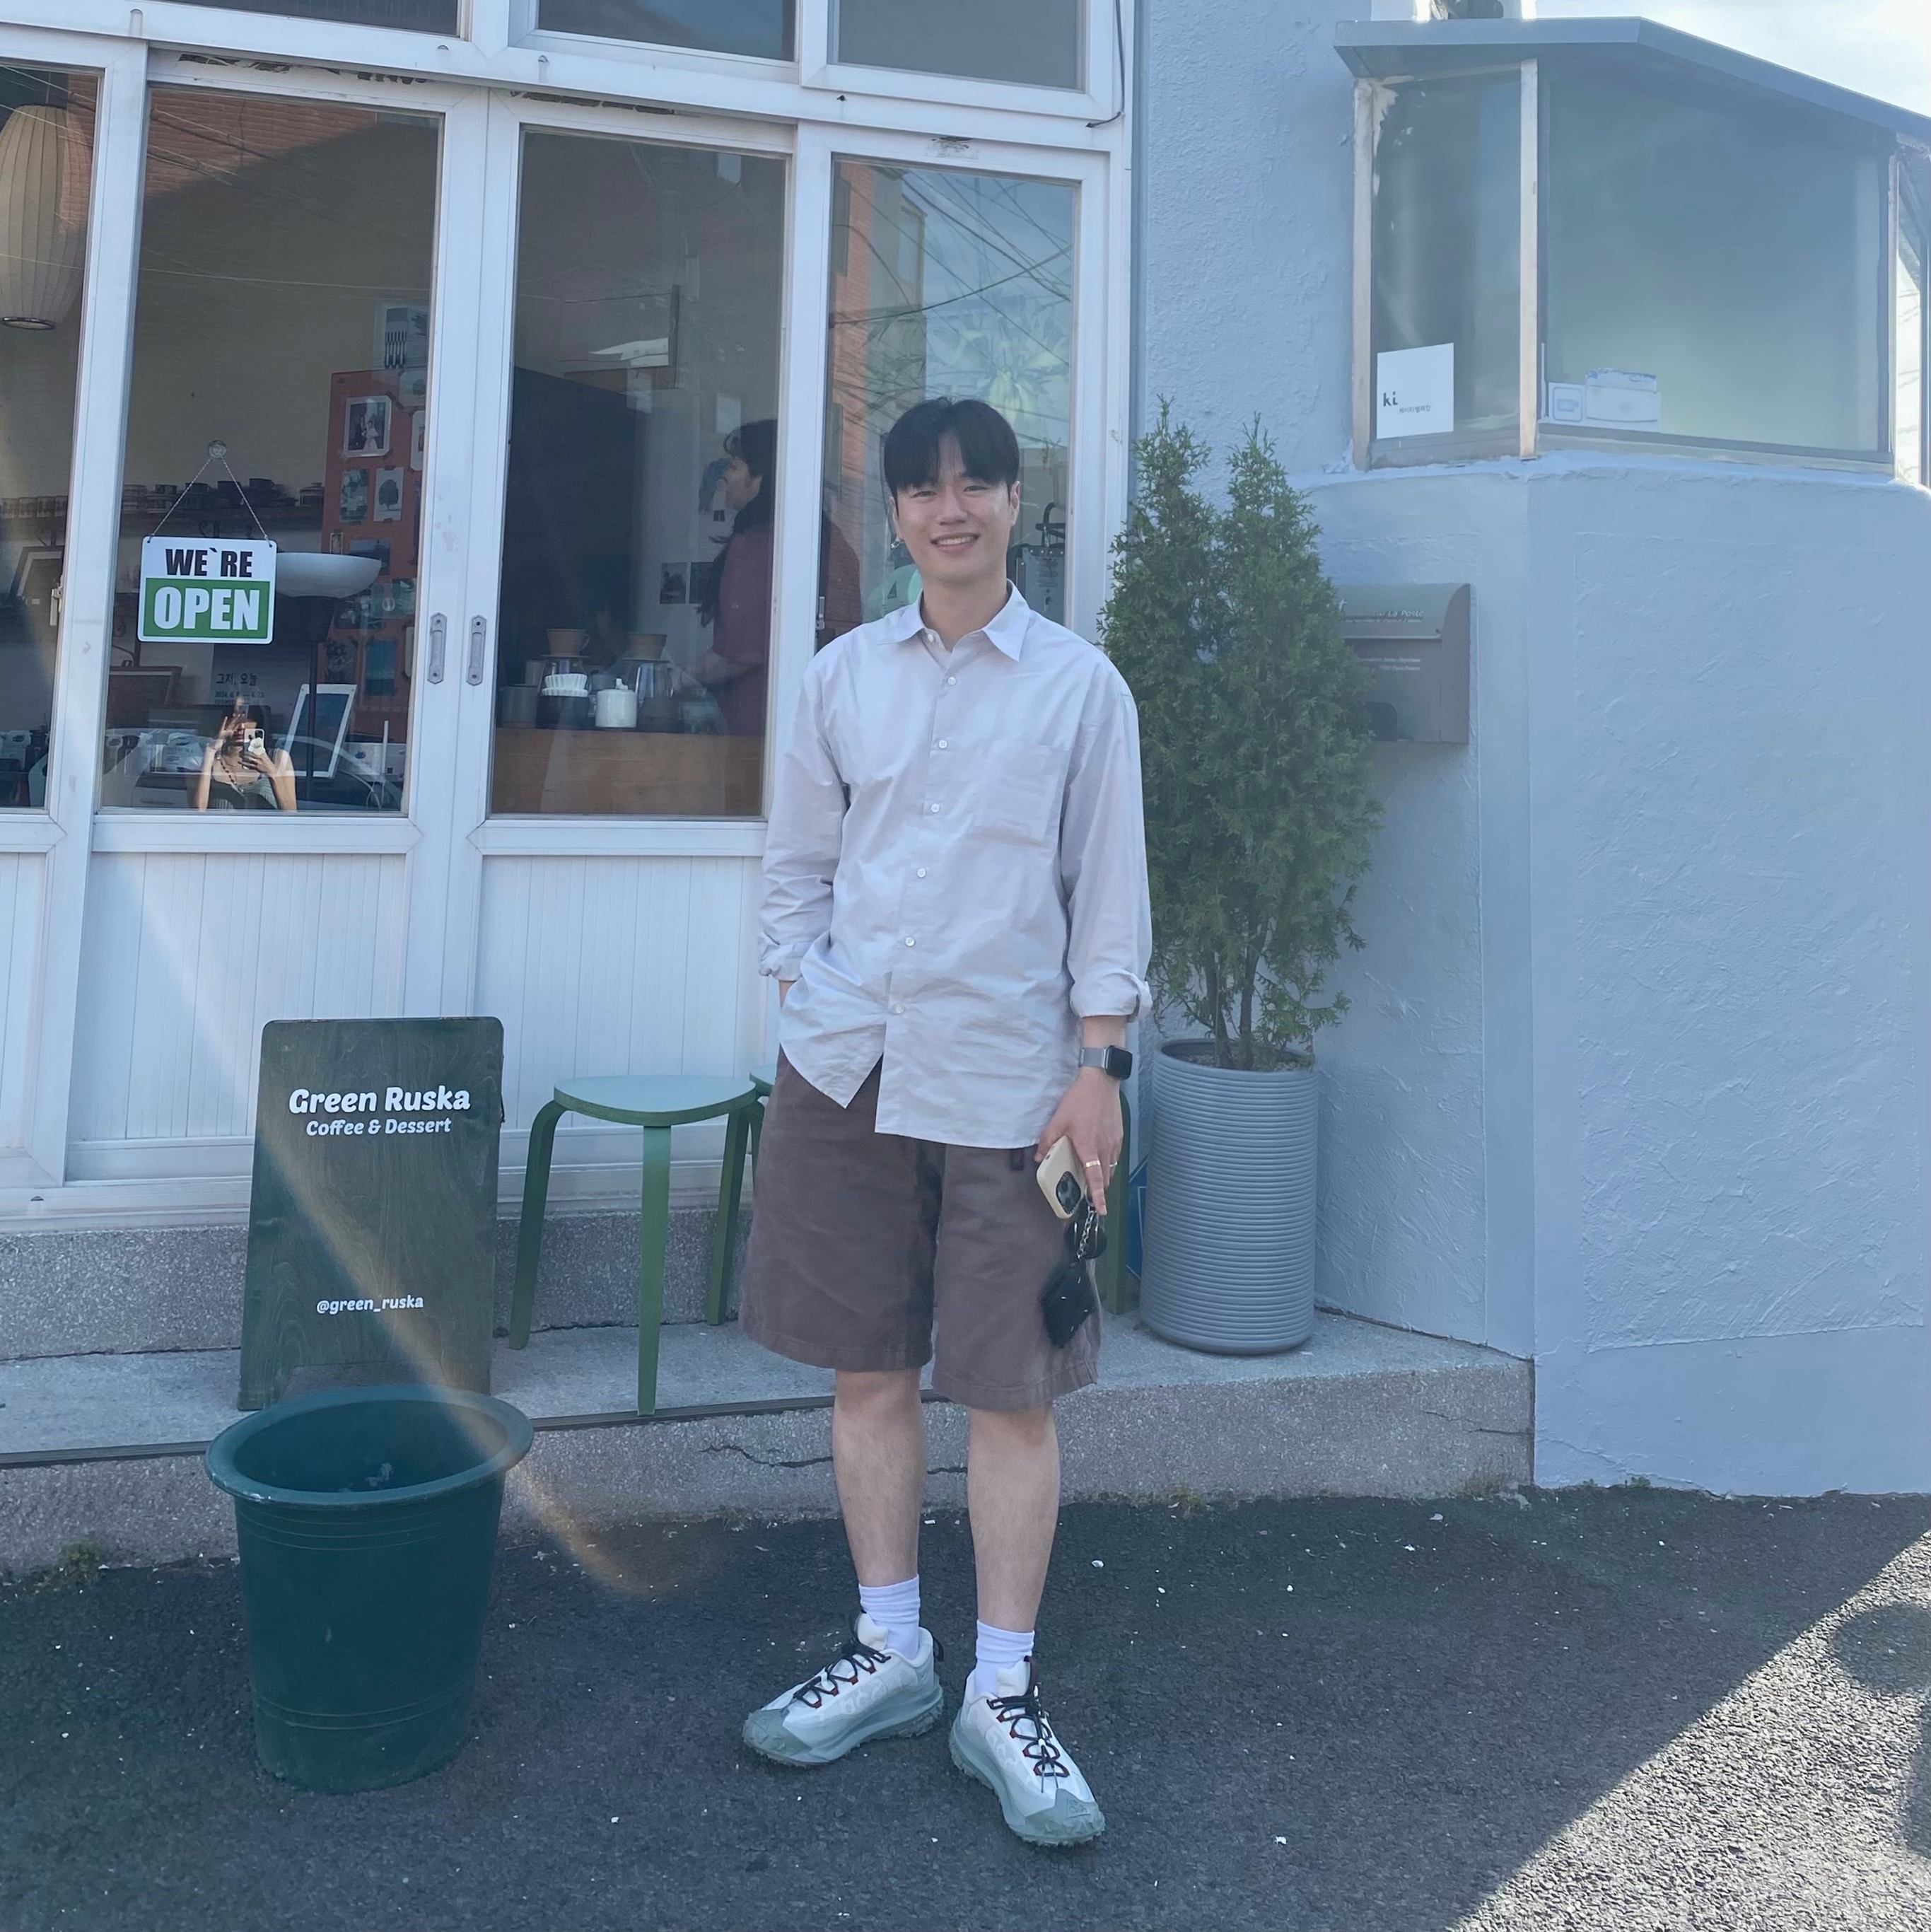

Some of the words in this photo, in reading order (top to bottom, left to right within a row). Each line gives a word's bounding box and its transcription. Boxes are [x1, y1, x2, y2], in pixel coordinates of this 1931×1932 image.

[153, 586, 260, 631] OPEN
[240, 673, 257, 686] 오늘
[288, 1088, 378, 1114] Green
[385, 1085, 471, 1112] Ruska
[306, 1119, 365, 1136] Coffee
[368, 1119, 381, 1135] &
[385, 1117, 452, 1134] Dessert
[316, 1294, 424, 1315] @green_ruska
